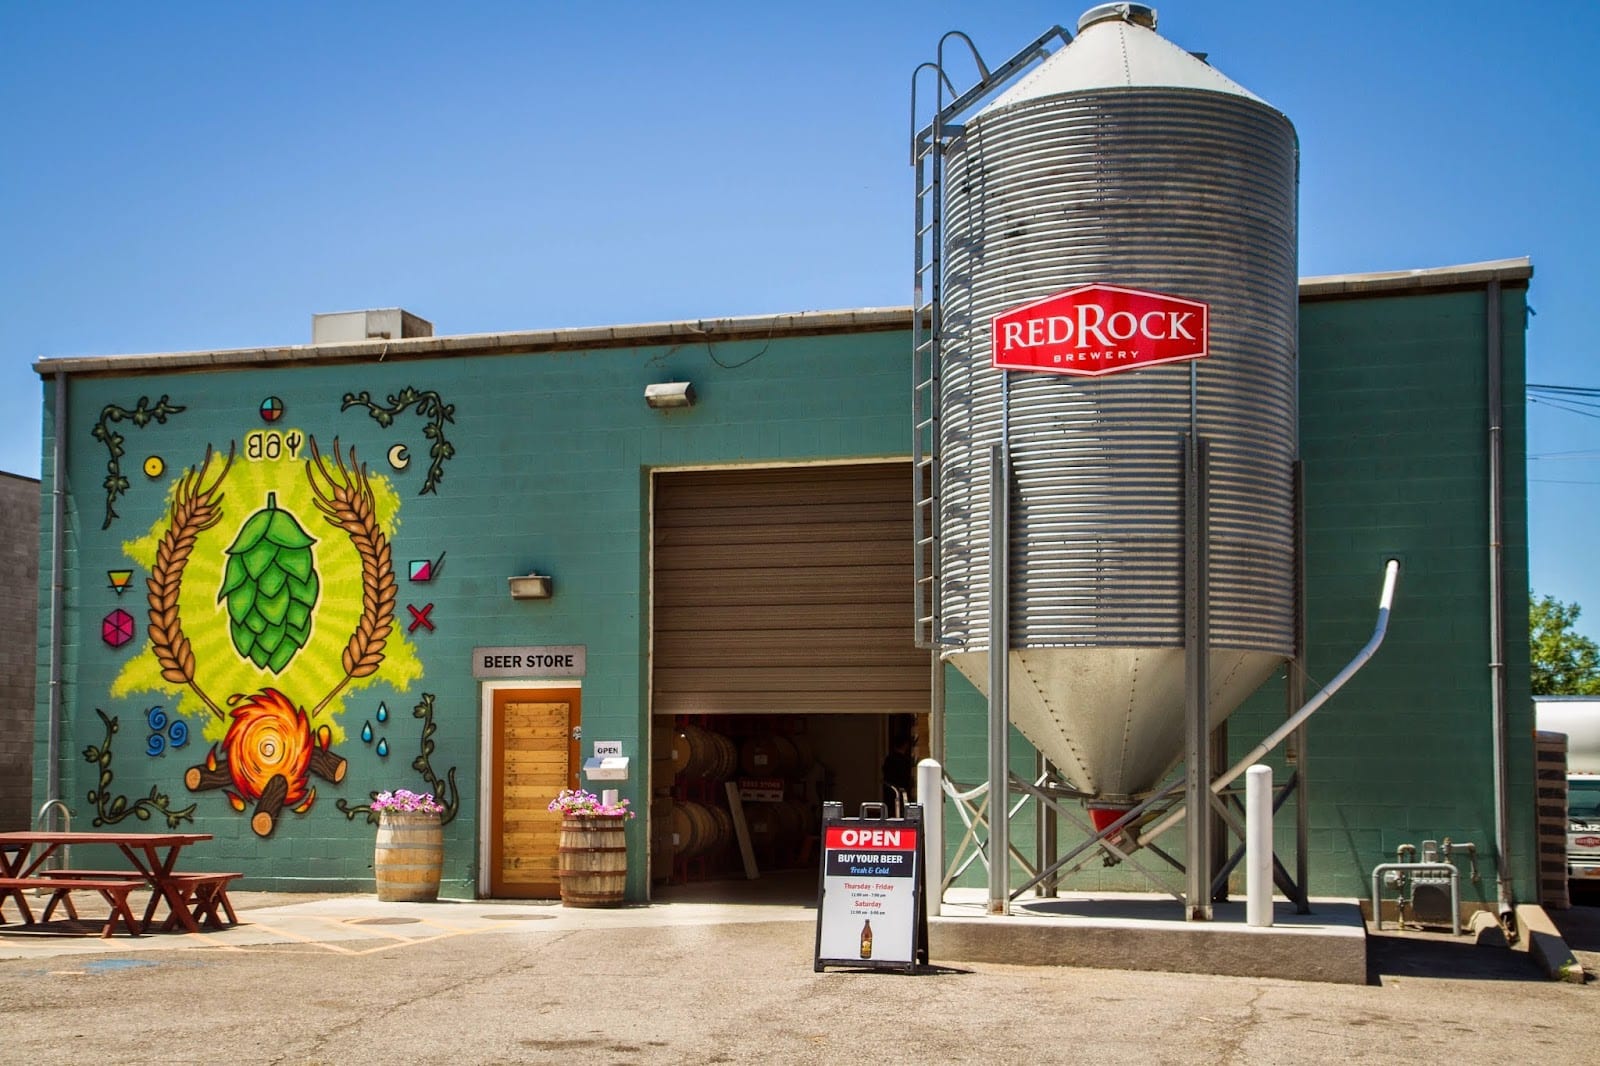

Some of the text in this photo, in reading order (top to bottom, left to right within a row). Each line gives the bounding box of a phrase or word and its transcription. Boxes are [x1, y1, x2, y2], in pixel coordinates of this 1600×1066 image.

[1053, 350, 1140, 363] BREWERY
[484, 654, 574, 669] BEER STORE
[841, 830, 901, 847] OPEN
[838, 853, 903, 864] BUY YOUR BEER
[850, 866, 868, 874] Fresh
[844, 882, 871, 890] Thursday
[875, 883, 894, 891] Friday
